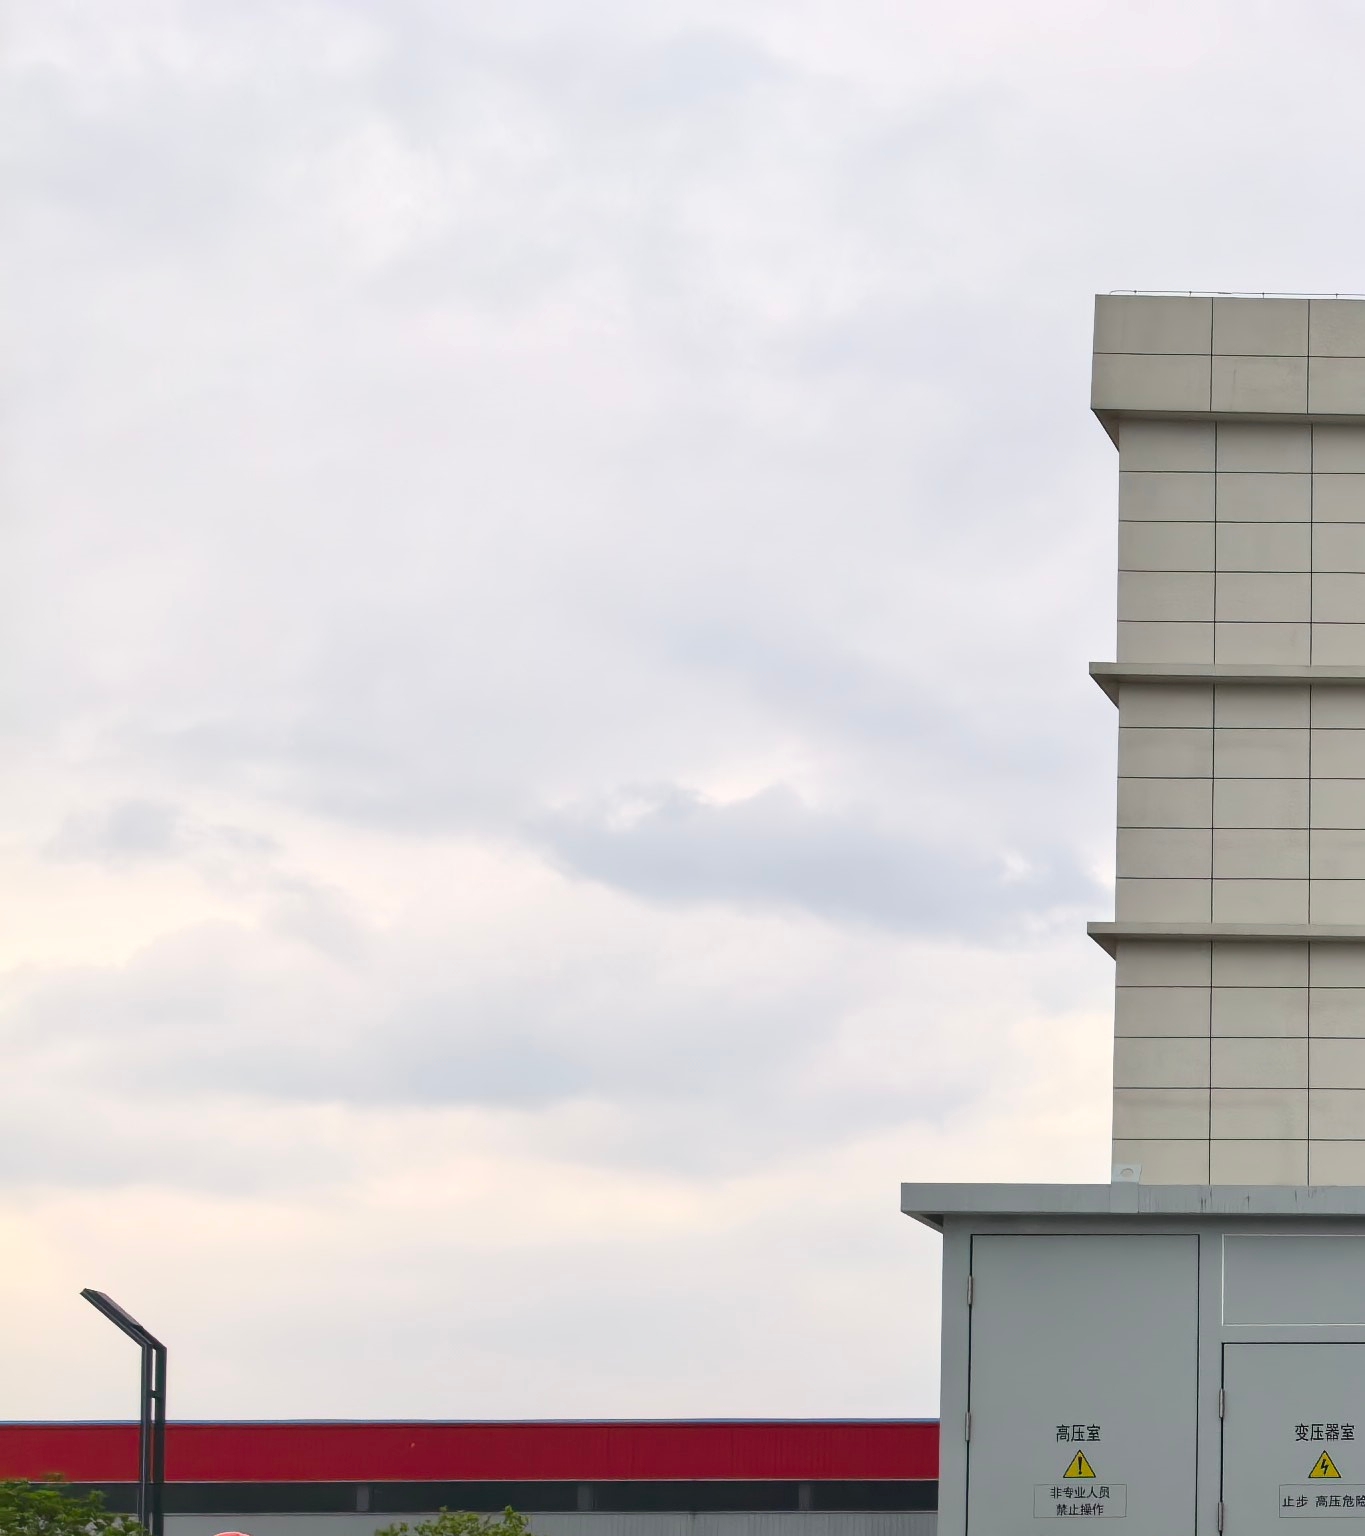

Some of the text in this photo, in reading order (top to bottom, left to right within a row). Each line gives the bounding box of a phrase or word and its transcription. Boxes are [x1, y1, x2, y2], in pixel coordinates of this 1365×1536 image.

[1056, 1424, 1101, 1442] 高压室
[1295, 1423, 1355, 1442] 变压器室
[1050, 1486, 1110, 1499] 非专业人员
[1282, 1495, 1308, 1508] 止步
[1056, 1503, 1104, 1516] 禁止操作
